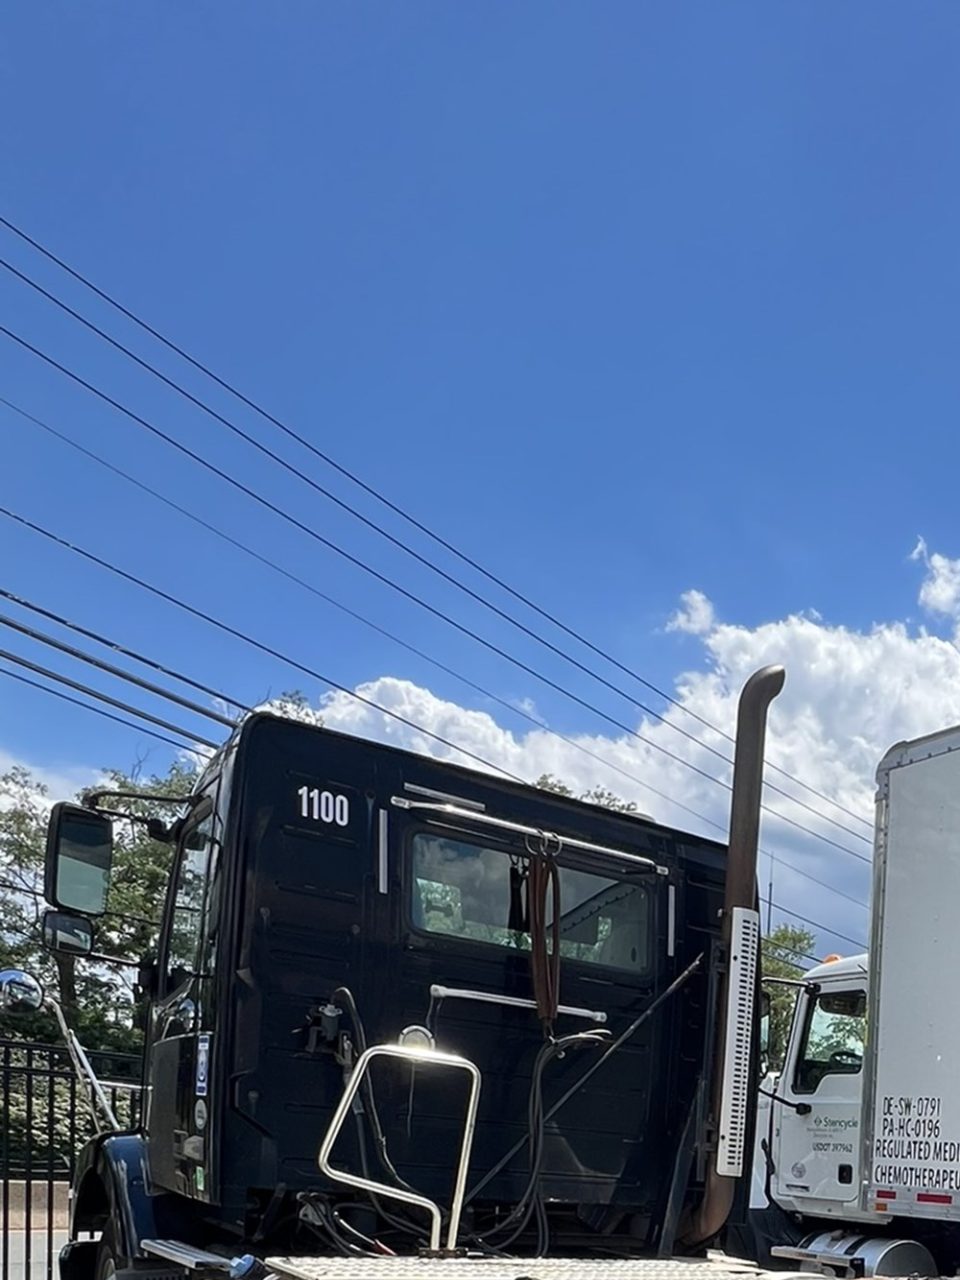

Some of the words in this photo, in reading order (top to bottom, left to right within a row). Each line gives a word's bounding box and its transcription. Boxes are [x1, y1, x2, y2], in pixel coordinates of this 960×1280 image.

[298, 786, 349, 827] 1100
[883, 1097, 941, 1117] DE-SW-0791
[882, 1117, 940, 1138] PA-HC-0196
[875, 1139, 931, 1161] REGULATED
